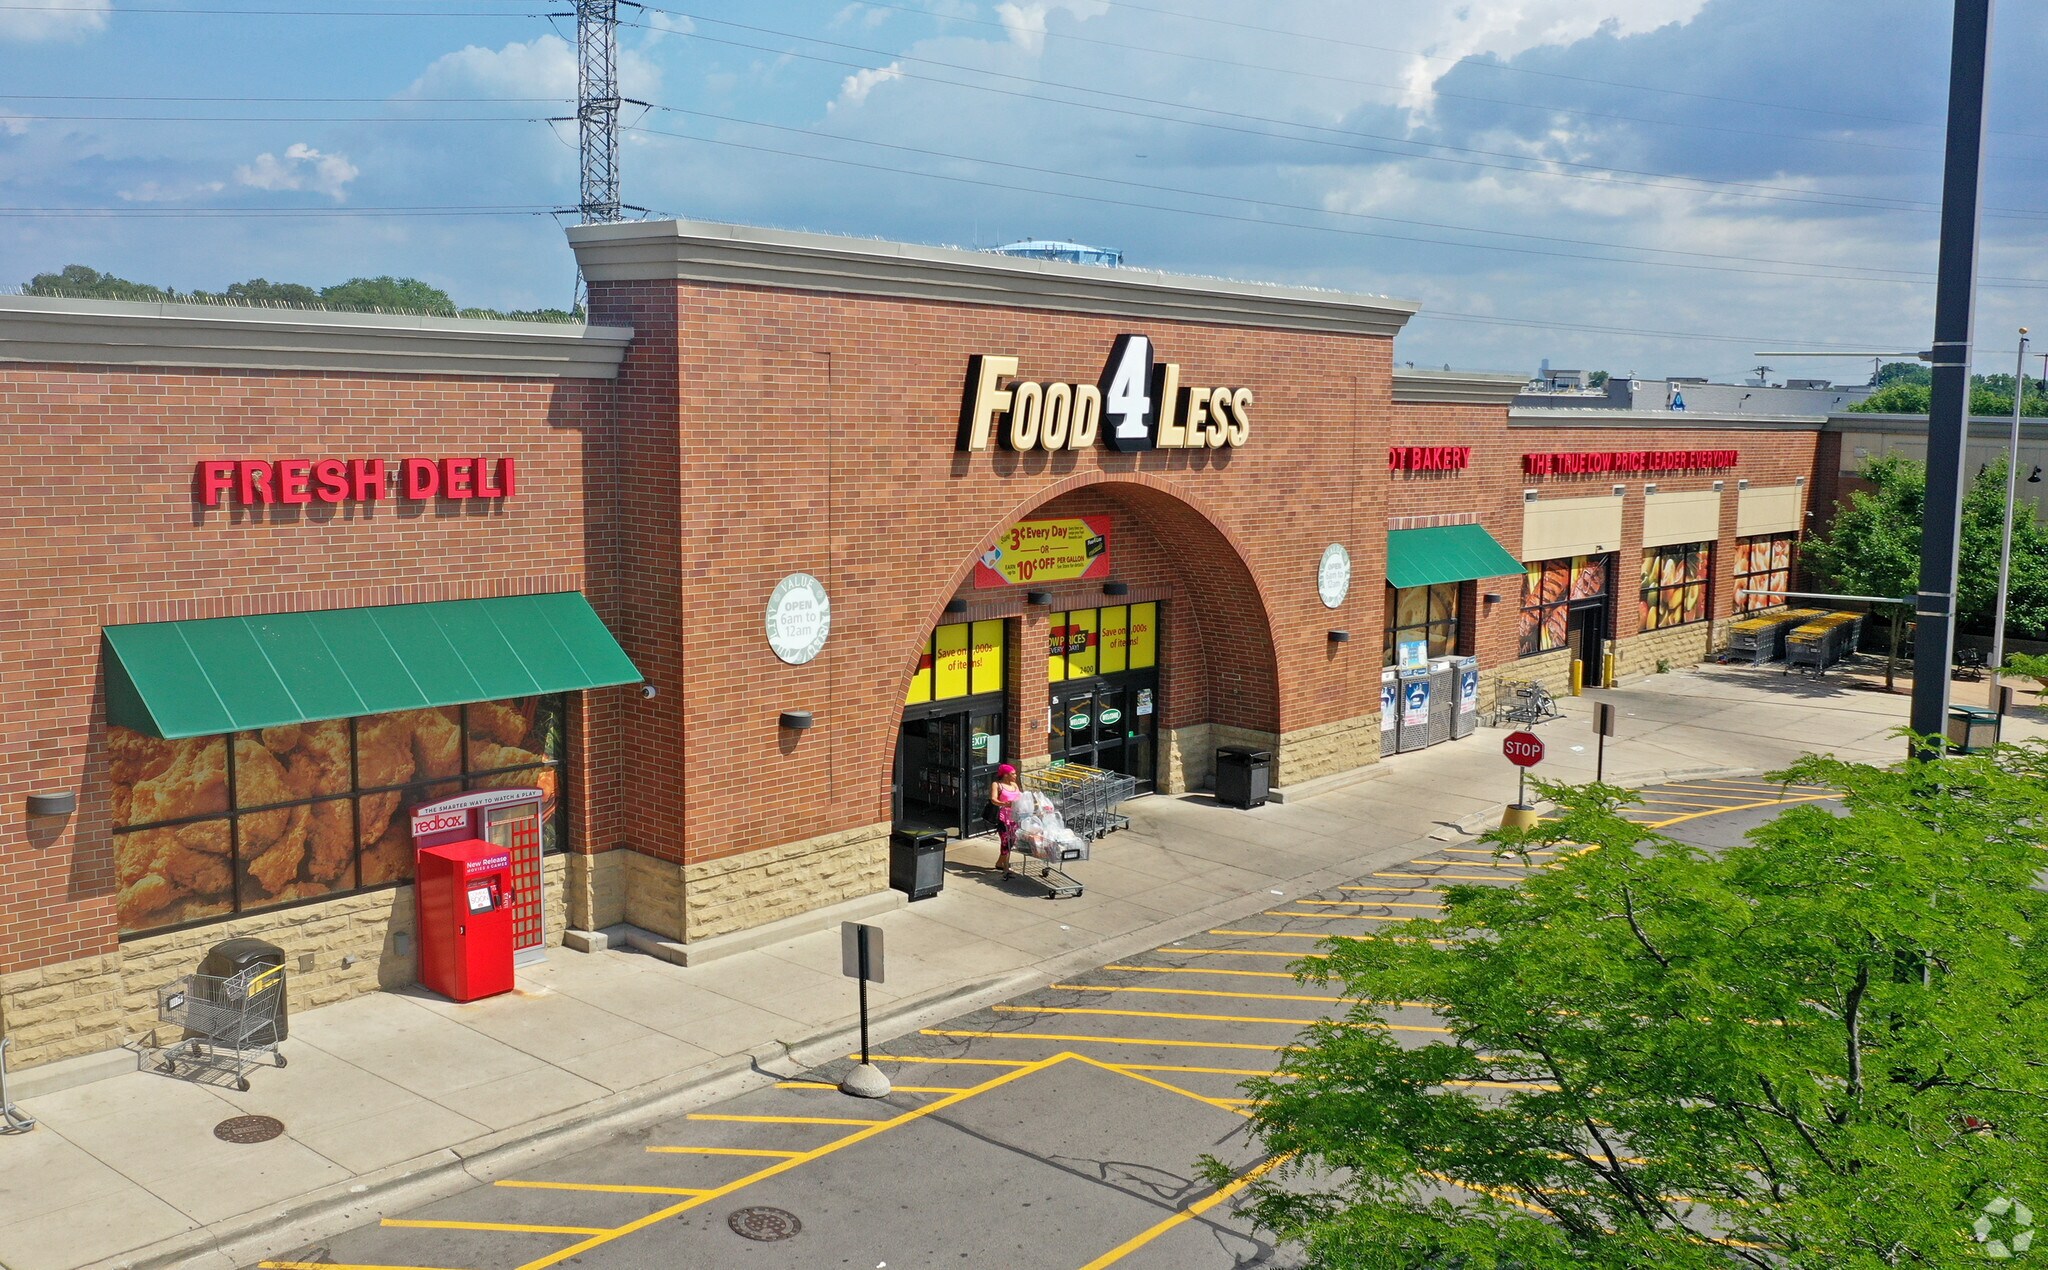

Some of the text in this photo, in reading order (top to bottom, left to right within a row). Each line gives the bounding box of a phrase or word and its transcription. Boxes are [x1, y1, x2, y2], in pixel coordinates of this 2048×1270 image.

[1105, 336, 1151, 440] 4
[1389, 447, 1472, 471] OT BAKERY
[1528, 453, 1551, 475] THE
[1557, 453, 1586, 474] TRUE
[1587, 453, 1612, 473] LOW
[1615, 452, 1646, 471] PRICE
[1650, 451, 1687, 470] LEADER
[200, 456, 515, 506] FRESH DELI
[1027, 527, 1050, 540] Every
[1051, 525, 1068, 539] Day
[1040, 545, 1050, 553] OR
[1038, 557, 1056, 570] OFF
[781, 575, 815, 593] VALUE
[785, 600, 812, 611] OPEN
[781, 612, 816, 625] 6am to
[785, 625, 812, 637] 12am
[1102, 627, 1117, 637] Save
[1131, 623, 1148, 634] ,000s
[1049, 636, 1060, 648] OW
[1110, 638, 1117, 649] of
[937, 643, 993, 659] Save on ,000s
[1050, 645, 1065, 654] VERY
[947, 660, 956, 671] of
[1079, 665, 1094, 675] 2400
[1505, 740, 1541, 757] STOP
[439, 802, 468, 812] SMARTER
[469, 799, 482, 807] WAY
[522, 790, 537, 798] PLAY
[482, 856, 508, 866] Release
